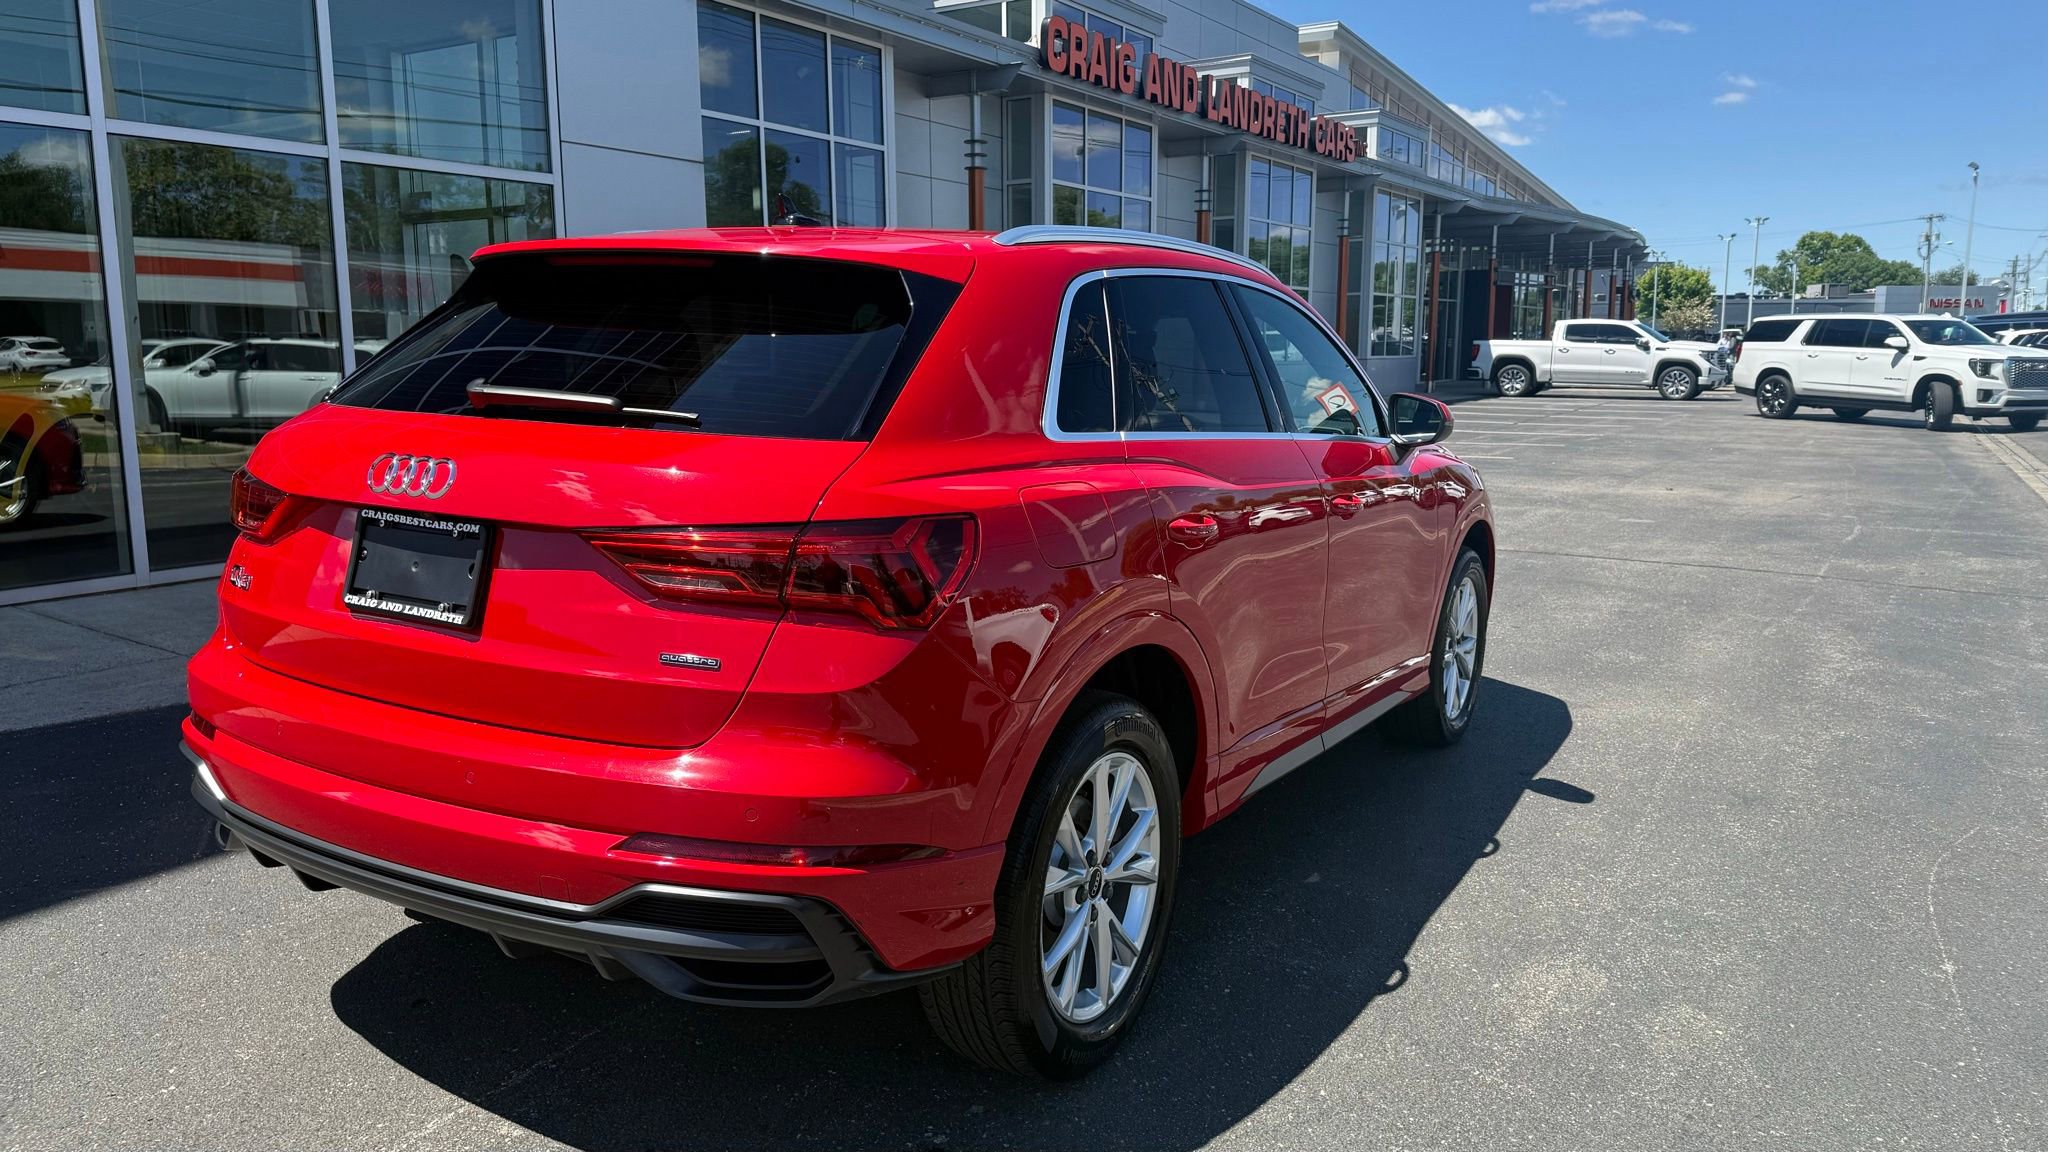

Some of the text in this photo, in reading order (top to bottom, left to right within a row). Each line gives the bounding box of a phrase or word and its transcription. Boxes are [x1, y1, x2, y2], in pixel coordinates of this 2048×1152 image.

[1044, 15, 1136, 95] CRAIG
[1144, 53, 1198, 113] AND
[1206, 74, 1310, 149] LANDRETH
[1316, 115, 1356, 162] CARS
[1929, 299, 1984, 309] NISSAN
[361, 509, 480, 533] CRAIGSBESTCARS.COM
[344, 594, 464, 625] CRAIG AND LANDRETH
[661, 654, 716, 665] quattro
